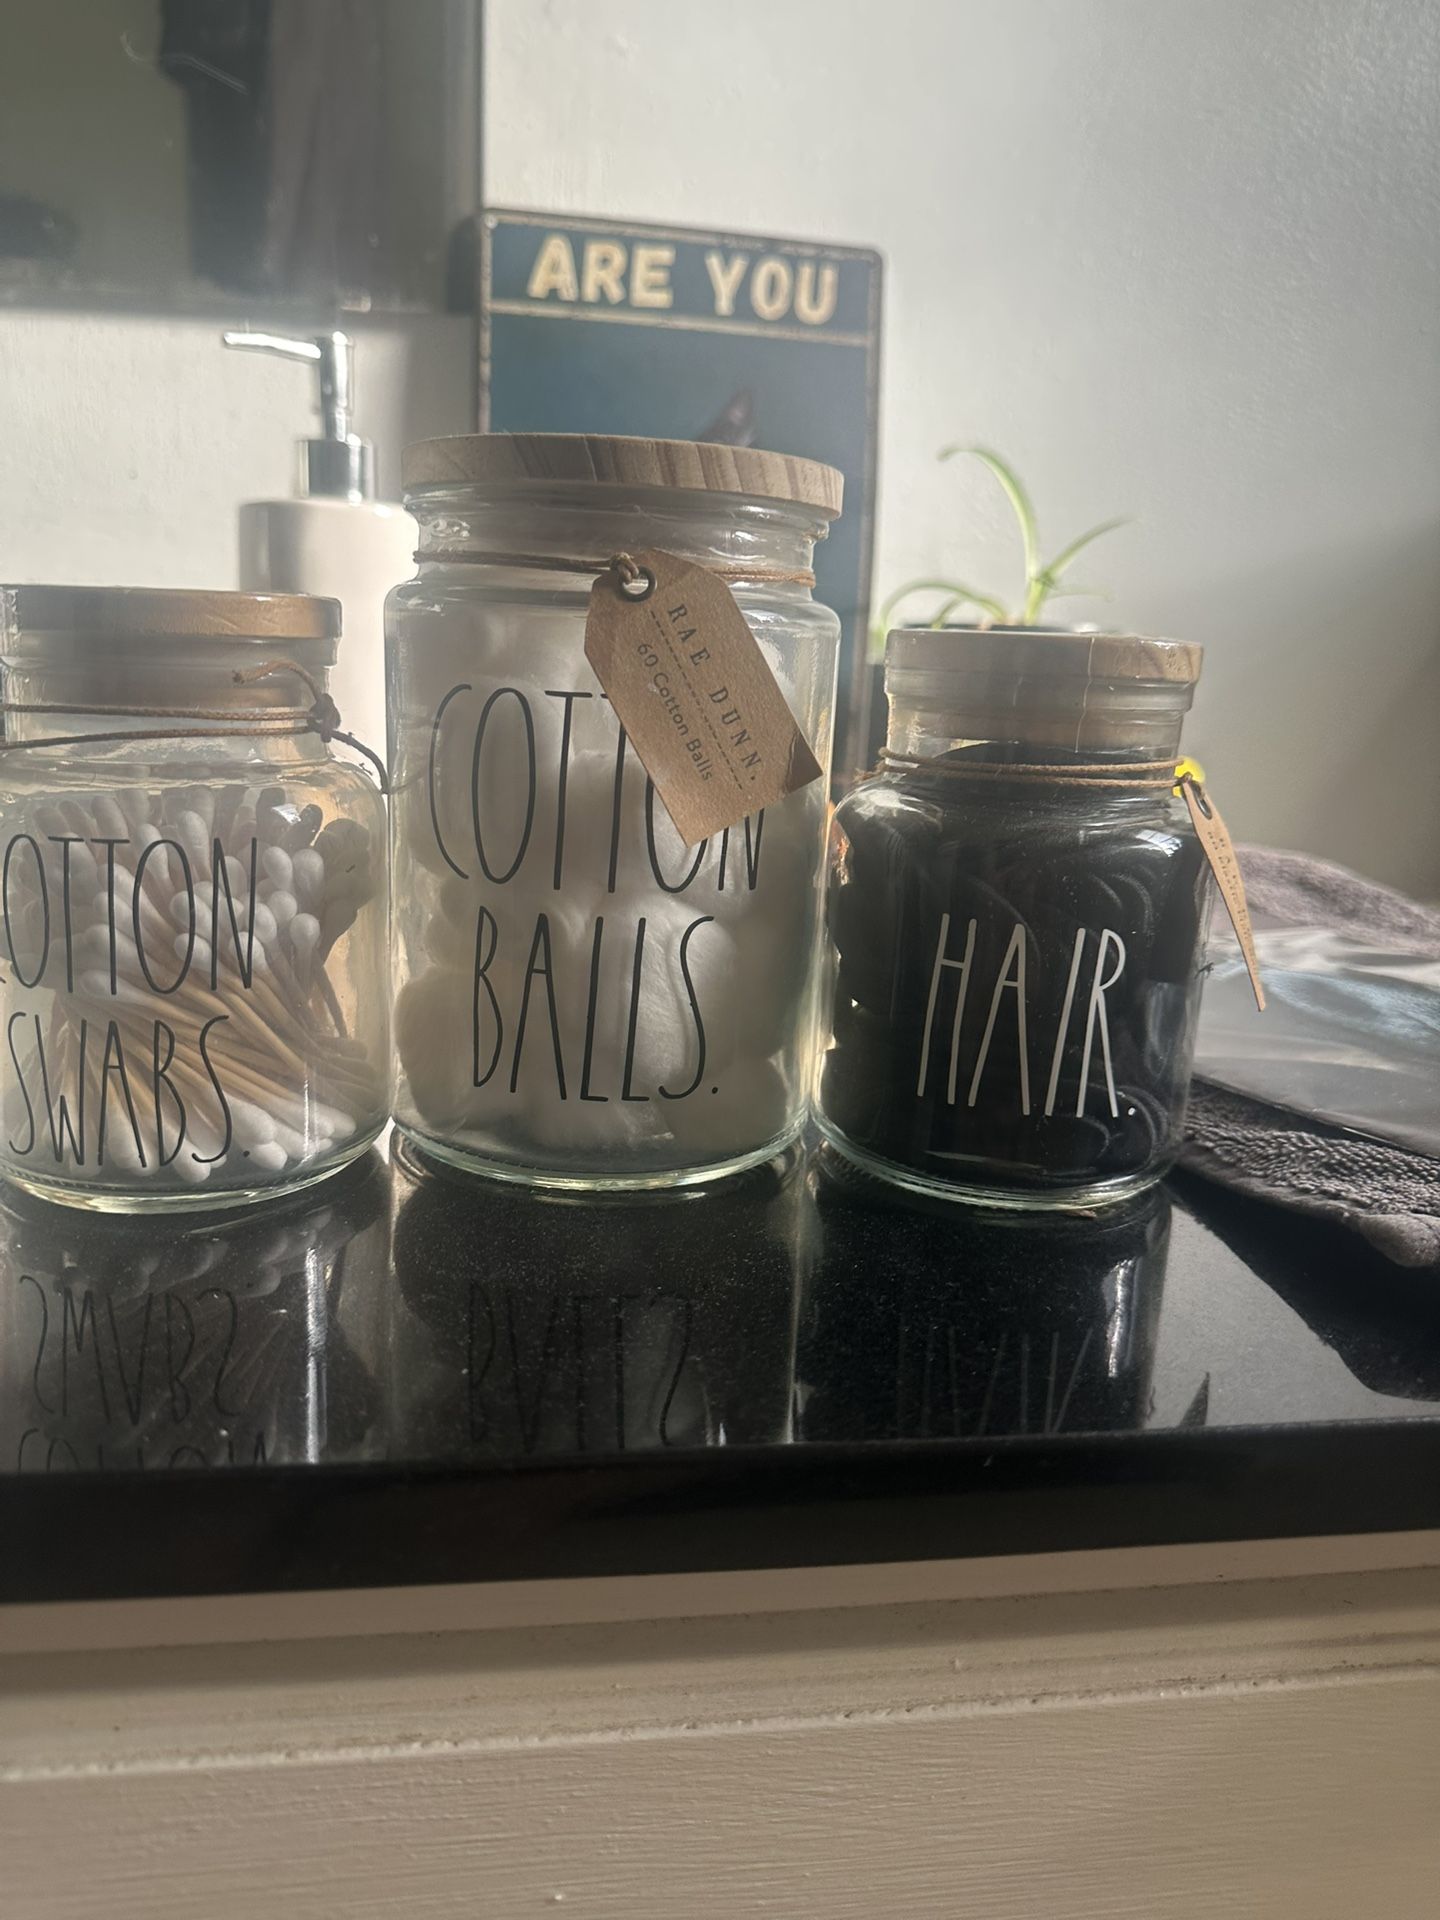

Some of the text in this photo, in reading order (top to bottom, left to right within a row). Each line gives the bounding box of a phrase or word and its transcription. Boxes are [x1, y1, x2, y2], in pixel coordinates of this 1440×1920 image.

[529, 234, 838, 325] ARE YOU
[637, 643, 712, 781] 60 Cotton Balls
[667, 603, 762, 781] RAE DUNN.
[0, 833, 257, 995] OTTON
[473, 906, 718, 1101] BALLS.
[917, 913, 1136, 1118] HAIR.
[8, 1012, 250, 1168] SWABS.
